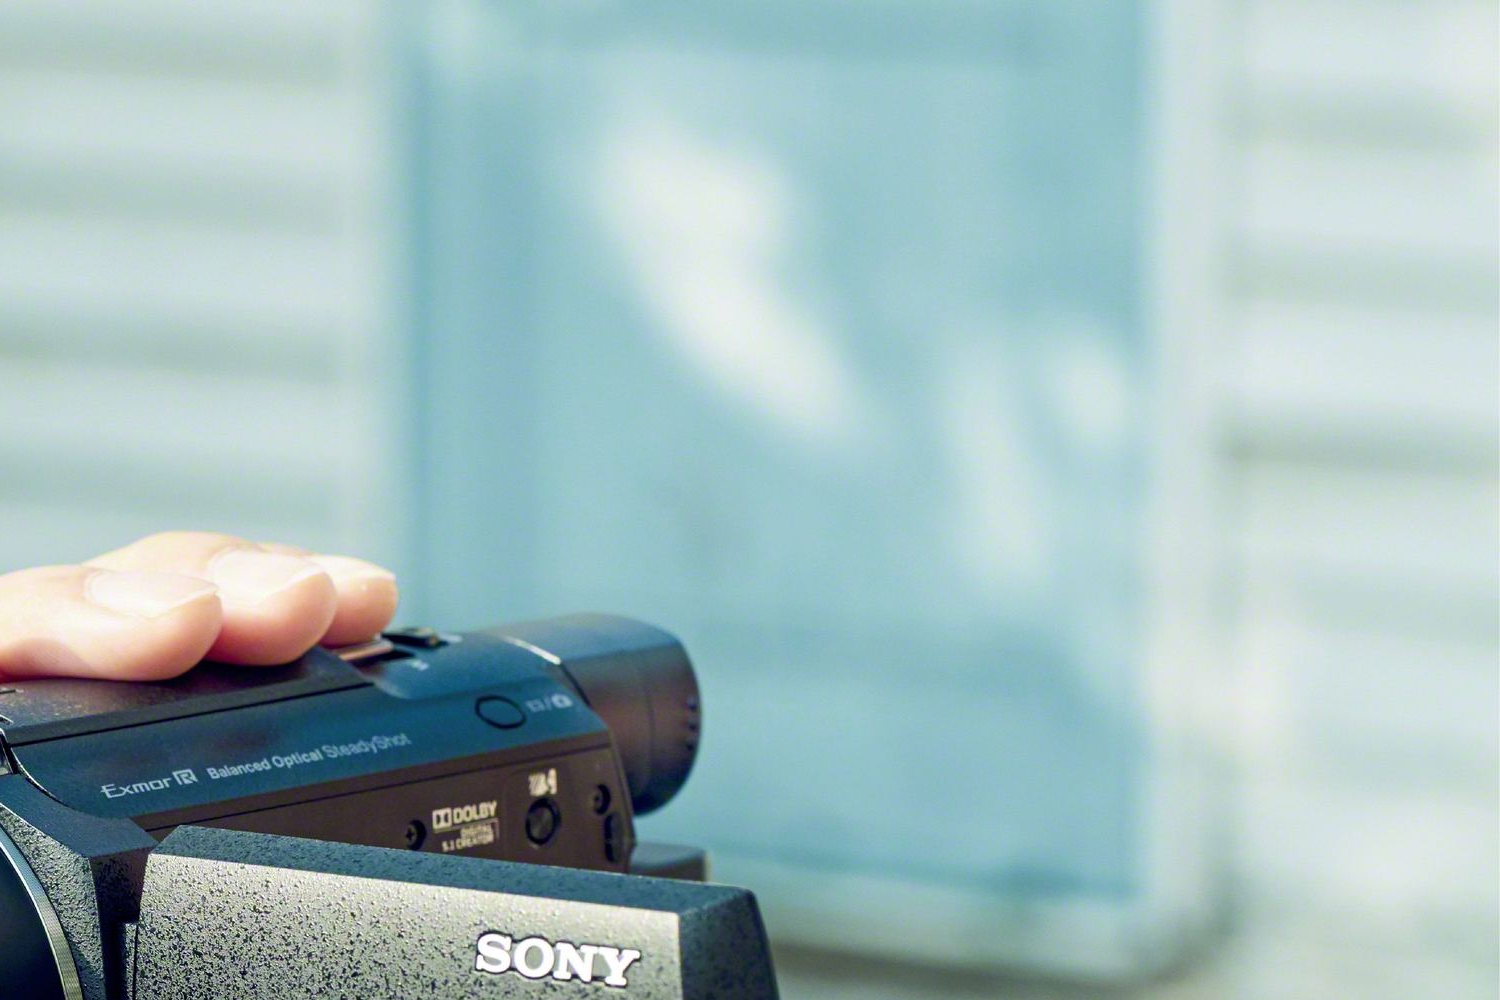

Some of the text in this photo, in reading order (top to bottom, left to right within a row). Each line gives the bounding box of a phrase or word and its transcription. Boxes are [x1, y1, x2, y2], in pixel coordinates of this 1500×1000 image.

[206, 732, 412, 780] Balanced Optical SteadyShot
[100, 776, 172, 799] Exmor
[453, 800, 498, 824] DOLBY
[474, 931, 641, 988] SONY
